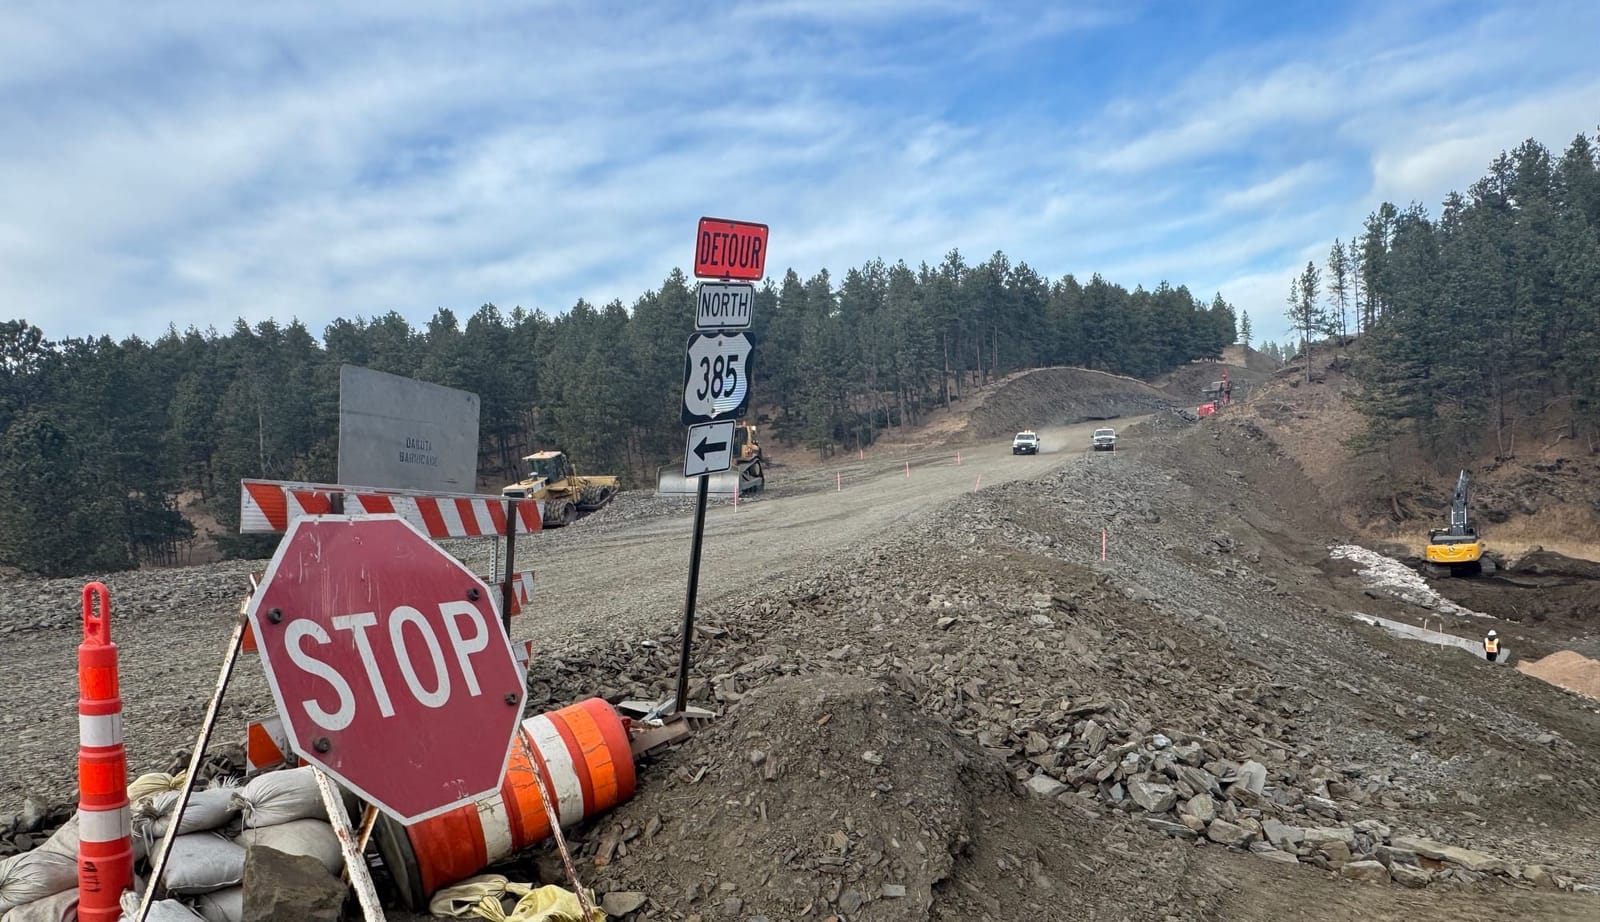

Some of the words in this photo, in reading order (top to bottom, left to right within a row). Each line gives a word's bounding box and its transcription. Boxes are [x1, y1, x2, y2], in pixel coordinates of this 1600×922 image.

[700, 231, 762, 269] DETOUR
[701, 292, 749, 317] NORTH
[697, 355, 739, 400] 385
[284, 600, 489, 731] STOP
